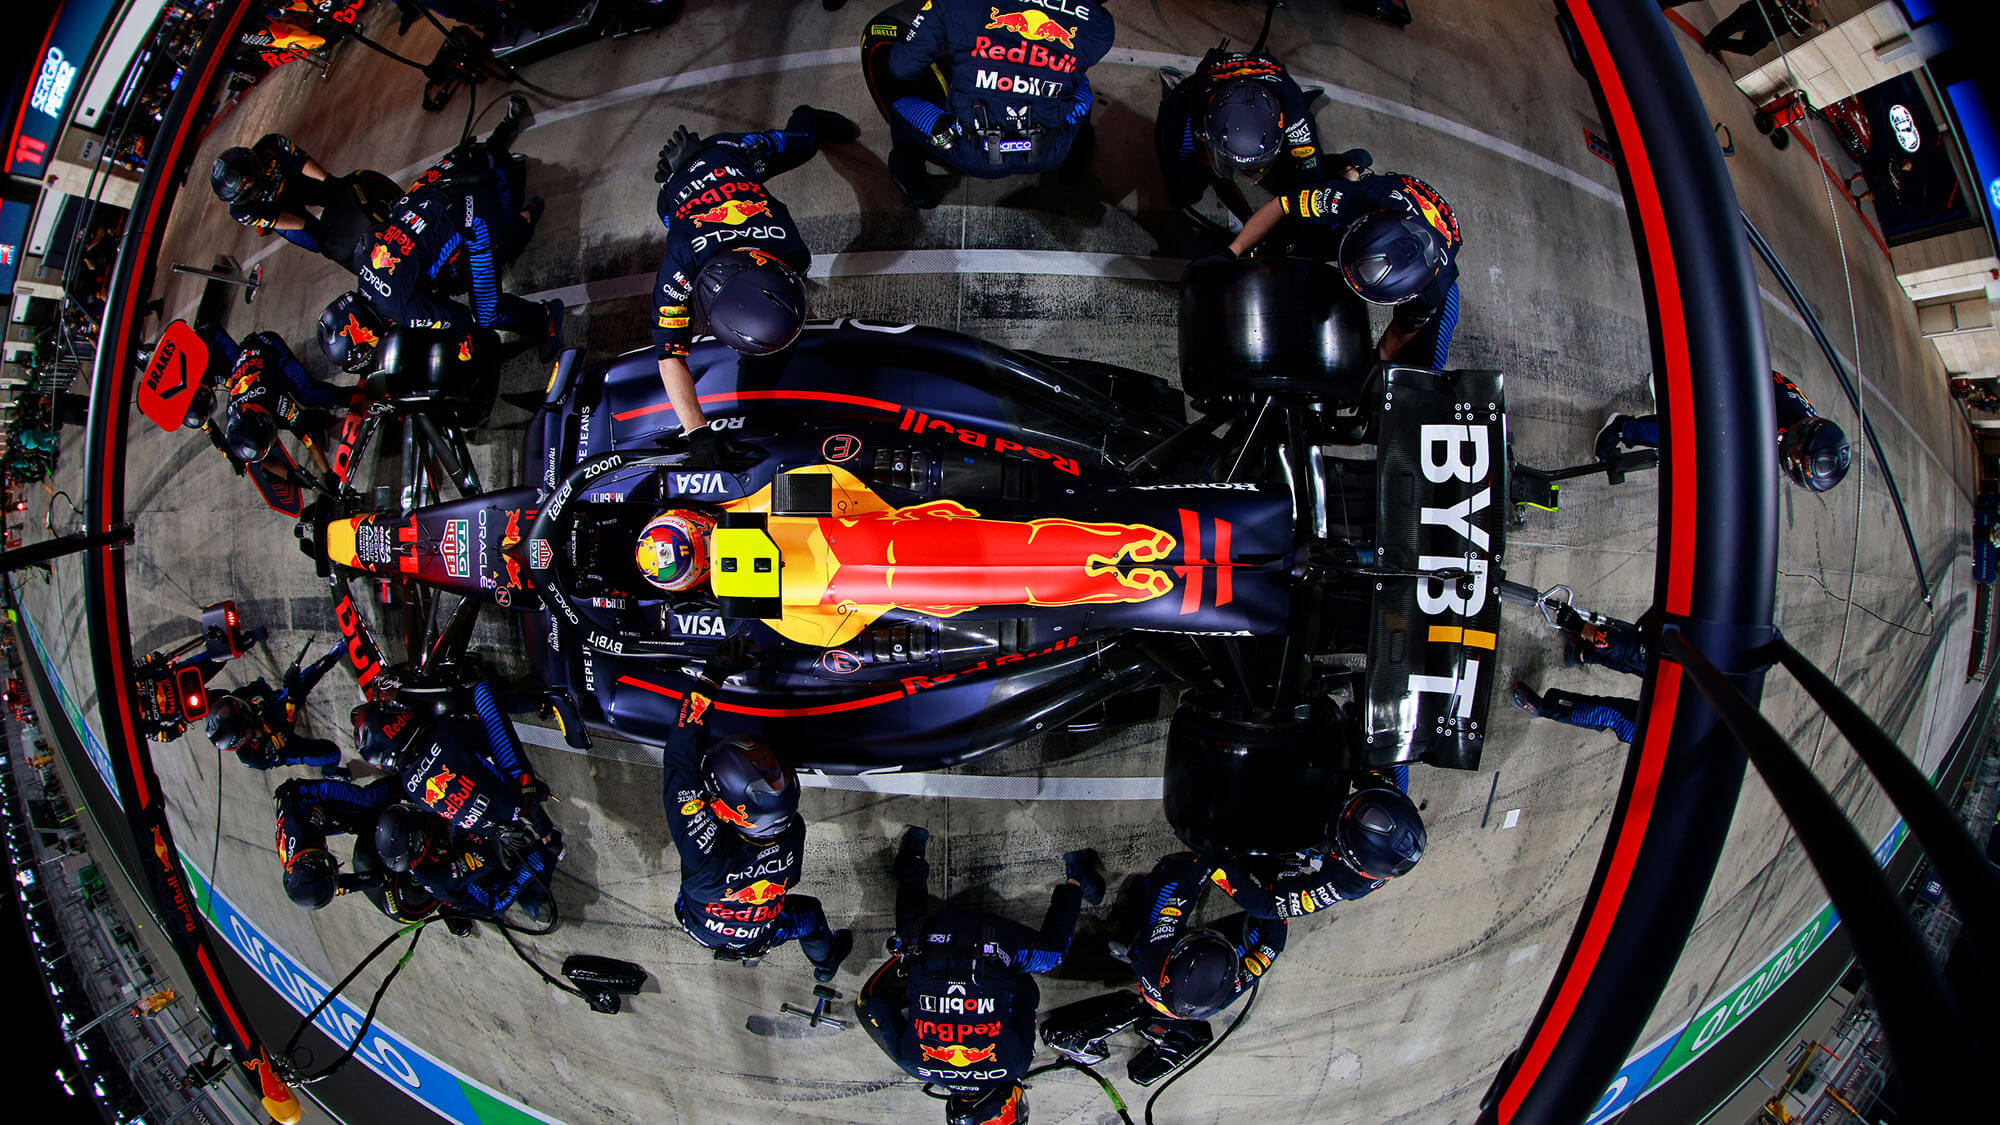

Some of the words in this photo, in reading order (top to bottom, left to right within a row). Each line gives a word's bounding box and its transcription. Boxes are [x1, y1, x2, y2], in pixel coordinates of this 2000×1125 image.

[871, 25, 897, 37] PIRELLI
[971, 36, 1027, 64] Red
[31, 46, 63, 112] SERGIO
[44, 60, 77, 120] PEREZ
[975, 69, 1040, 96] Mobil
[15, 135, 47, 165] 11
[691, 166, 744, 191] Mobil
[691, 226, 786, 252] ORACLE
[663, 284, 685, 301] Claro
[146, 340, 175, 392] BRAKES
[580, 405, 590, 446] JEANS
[711, 416, 746, 431] RO
[900, 408, 987, 449] Bull
[583, 454, 622, 479] zoom
[995, 438, 1080, 477] Red
[677, 473, 728, 493] VISA
[1133, 481, 1260, 493] HONDA
[548, 479, 573, 521] telcel
[599, 493, 624, 502] Mobil
[443, 523, 456, 573] HEUER
[458, 524, 467, 572] TAG
[479, 509, 488, 588] ORACLE
[540, 541, 551, 567] HEUER
[1407, 424, 1496, 719] BYBIT
[548, 582, 578, 624] ORACLE
[593, 597, 616, 608] Mobil
[673, 614, 726, 636] VISA
[586, 631, 623, 654] BYBIT
[584, 659, 595, 691] PEPE
[407, 742, 442, 793] ORACLE
[449, 775, 475, 809] Bull
[167, 875, 185, 904] Bull
[177, 903, 196, 932] Red
[705, 902, 755, 922] Red
[705, 919, 760, 938] Mobil
[1690, 919, 1820, 1052] aramco
[229, 914, 421, 1089] aramco
[939, 997, 995, 1015] Mobil
[957, 1020, 1002, 1043] Red
[917, 1067, 1008, 1080] ORACLE
